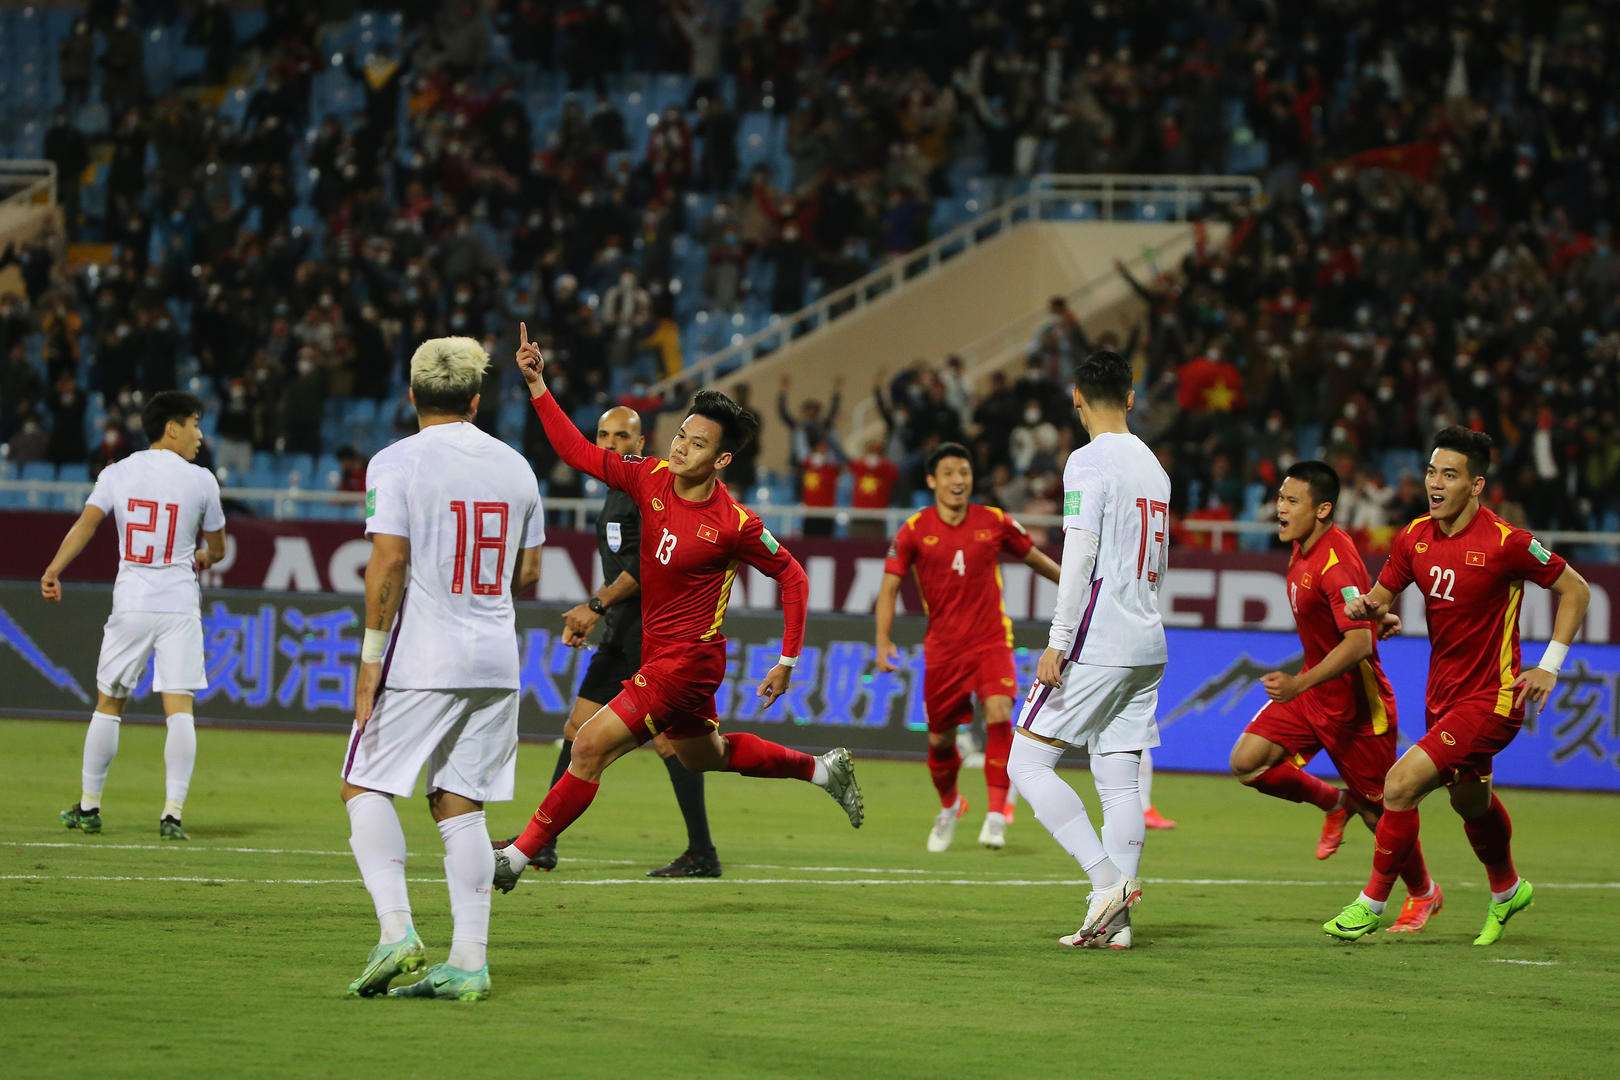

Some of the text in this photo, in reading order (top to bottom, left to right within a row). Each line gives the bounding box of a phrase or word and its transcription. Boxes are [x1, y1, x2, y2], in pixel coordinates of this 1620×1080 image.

[125, 498, 180, 565] 21
[450, 500, 509, 596] 18
[655, 527, 678, 565] 13
[952, 549, 966, 576] 4
[1429, 564, 1455, 603] 22
